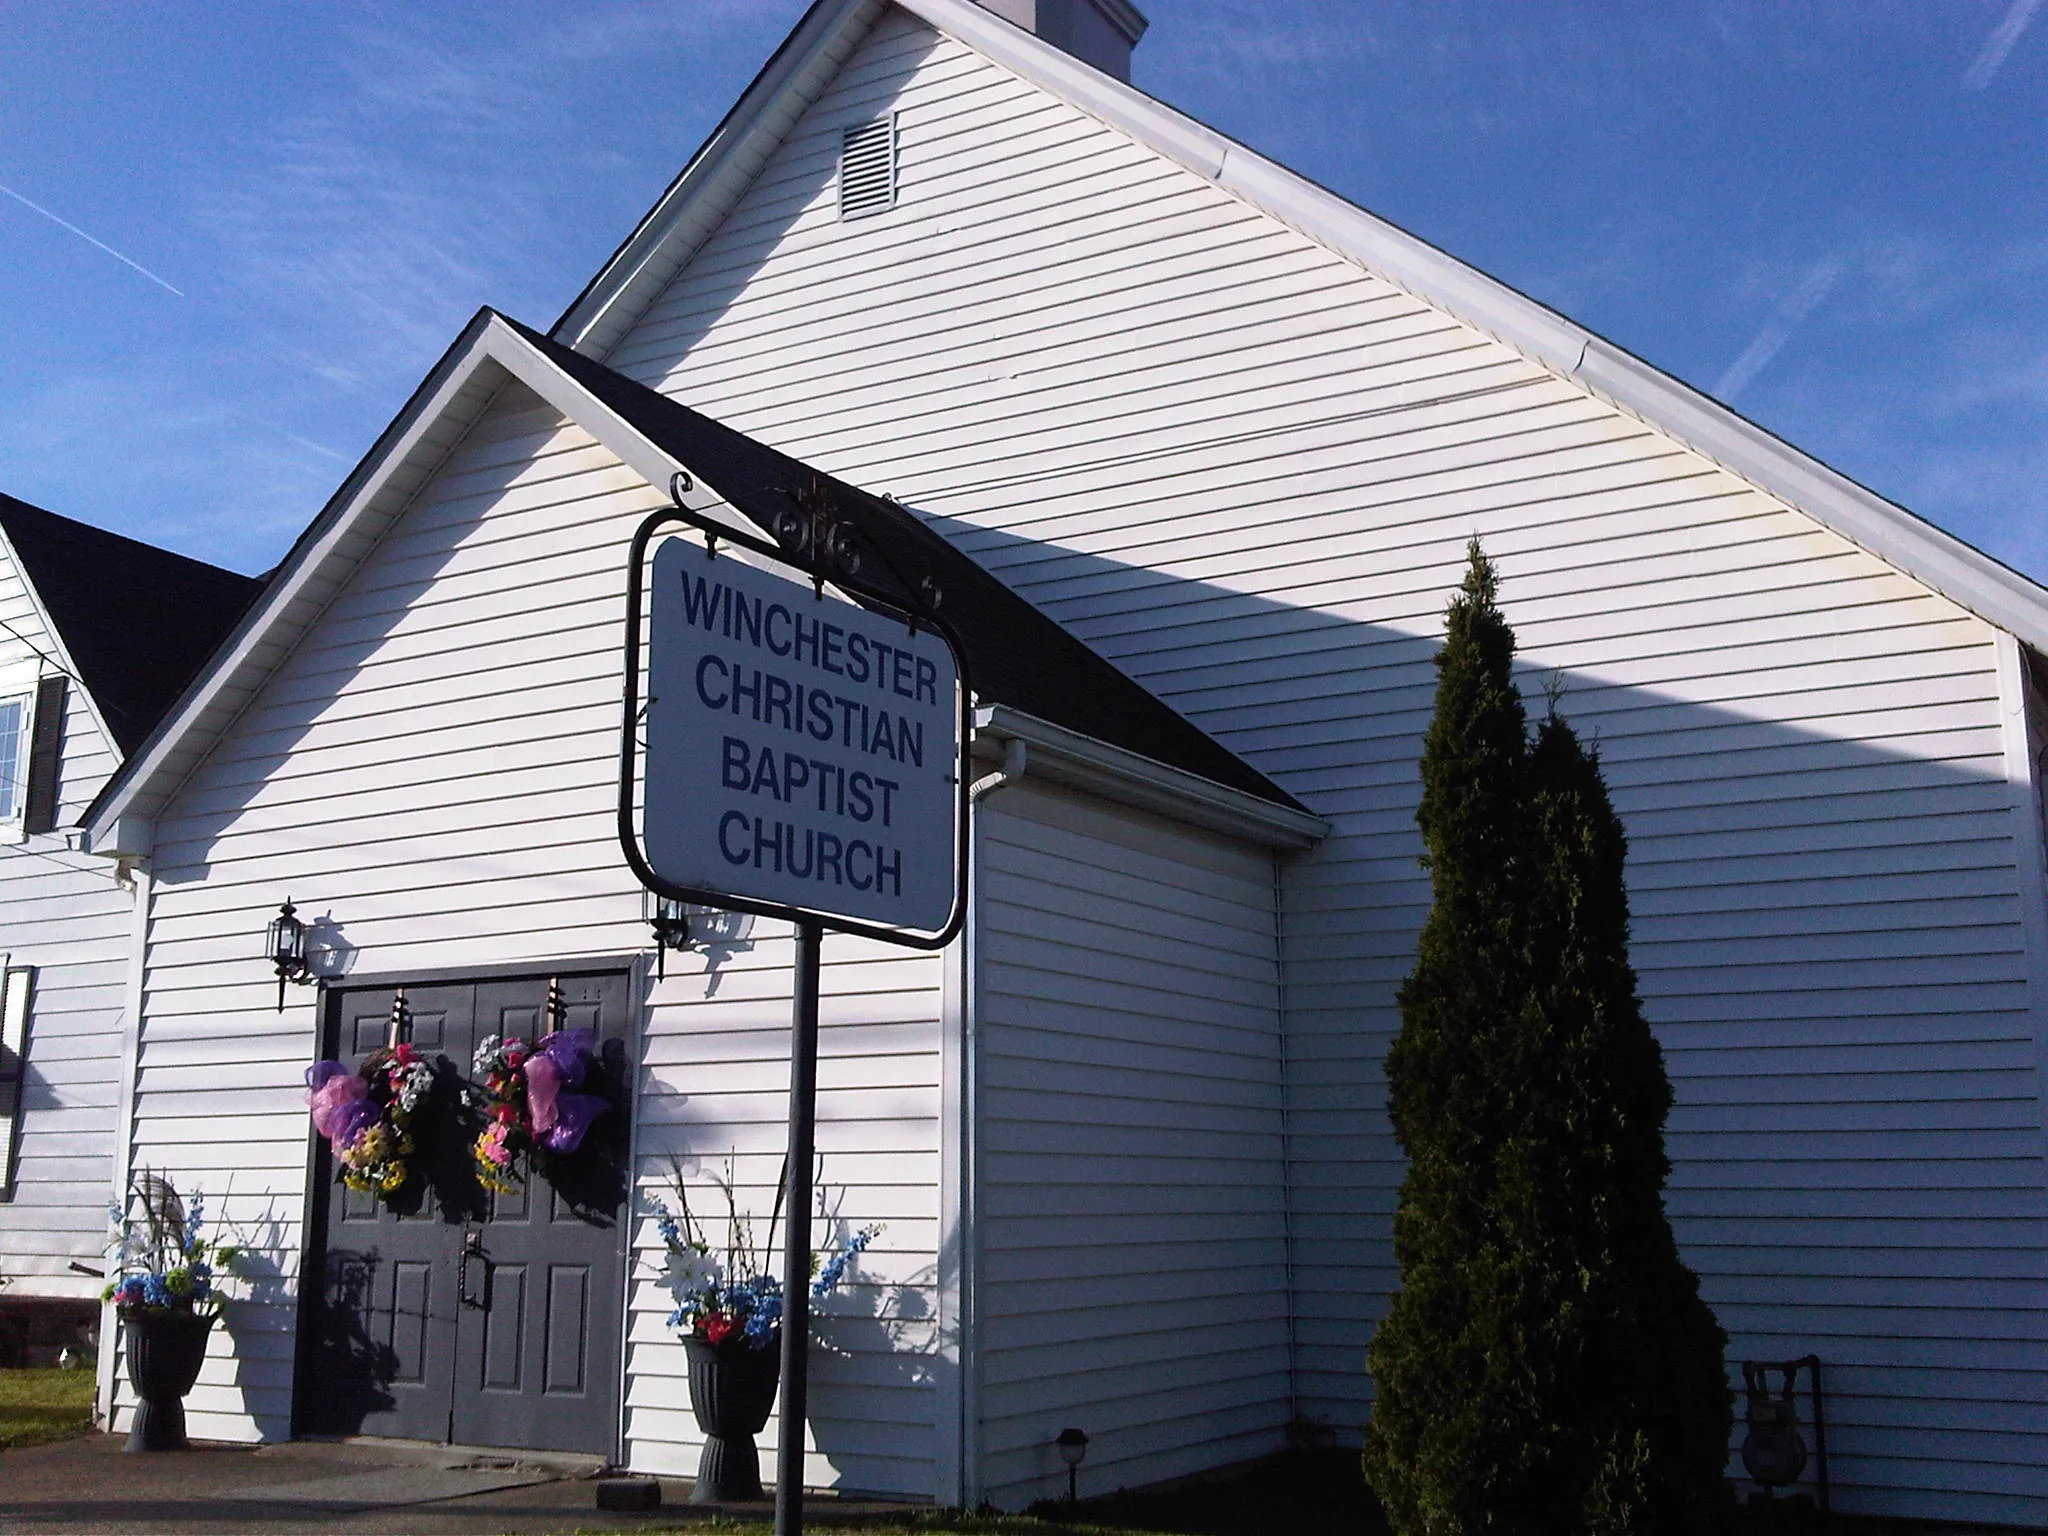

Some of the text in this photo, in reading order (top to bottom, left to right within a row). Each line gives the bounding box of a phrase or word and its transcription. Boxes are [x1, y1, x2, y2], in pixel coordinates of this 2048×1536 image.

[681, 571, 938, 706] WINCHESTER
[696, 655, 923, 767] CHRISTIAN
[722, 737, 899, 827] BAPTIST
[719, 810, 901, 896] CHURCH
